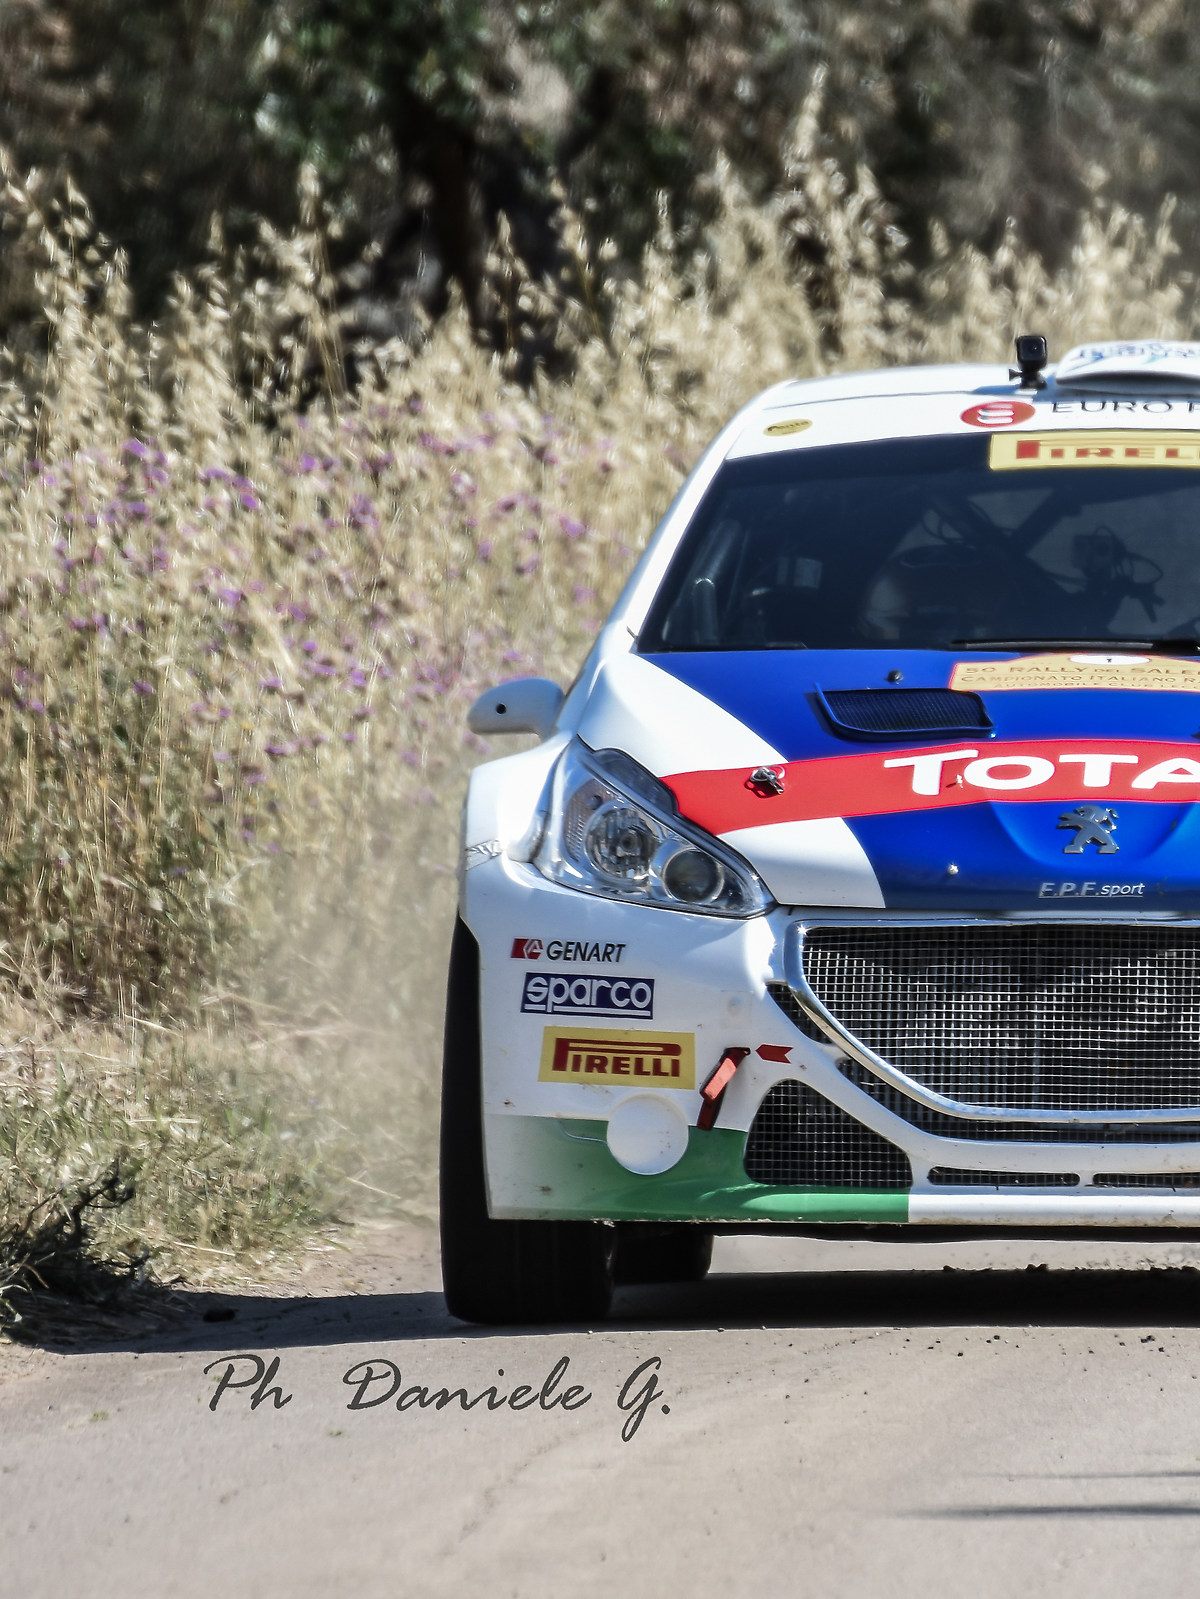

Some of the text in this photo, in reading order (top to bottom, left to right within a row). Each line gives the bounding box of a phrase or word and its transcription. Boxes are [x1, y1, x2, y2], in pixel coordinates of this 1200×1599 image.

[1051, 401, 1173, 414] EURO
[961, 674, 1083, 682] CAMPIONATO
[1090, 675, 1177, 683] ITALIANO
[546, 940, 626, 963] GENART
[526, 976, 652, 1013] sparco
[552, 1037, 682, 1078] PIRELLI
